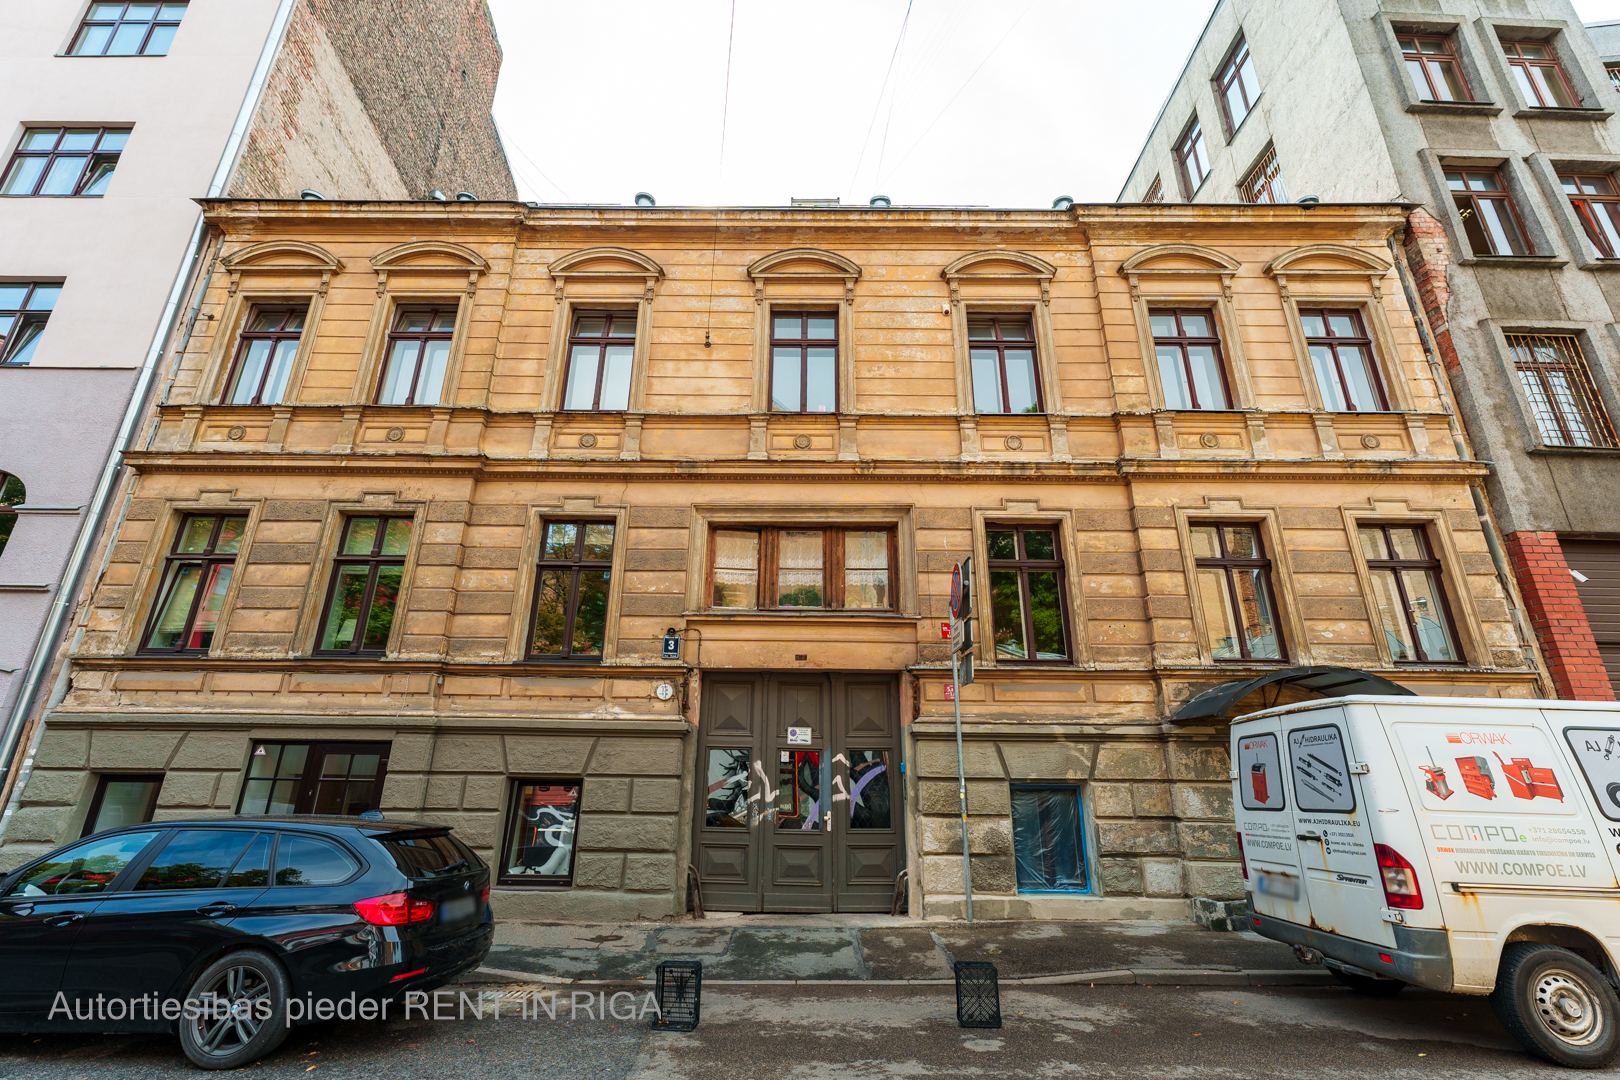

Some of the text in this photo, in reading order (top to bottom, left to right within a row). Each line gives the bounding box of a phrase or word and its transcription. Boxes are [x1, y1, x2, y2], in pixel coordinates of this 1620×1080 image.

[667, 640, 675, 650] 3
[1304, 733, 1338, 744] HIDRAULIKA
[1460, 731, 1512, 745] ORWAK
[1249, 740, 1269, 750] ORWAK
[1585, 740, 1602, 752] AJ
[1298, 818, 1361, 827] WWW.AJHIDRAULIKA.EU
[1528, 826, 1587, 836] +371 28654558
[1532, 835, 1590, 845] info@compoe.lv
[1246, 839, 1292, 852] WWW.COMPOE.LV
[1454, 860, 1586, 878] WWW.COMPOE.LV
